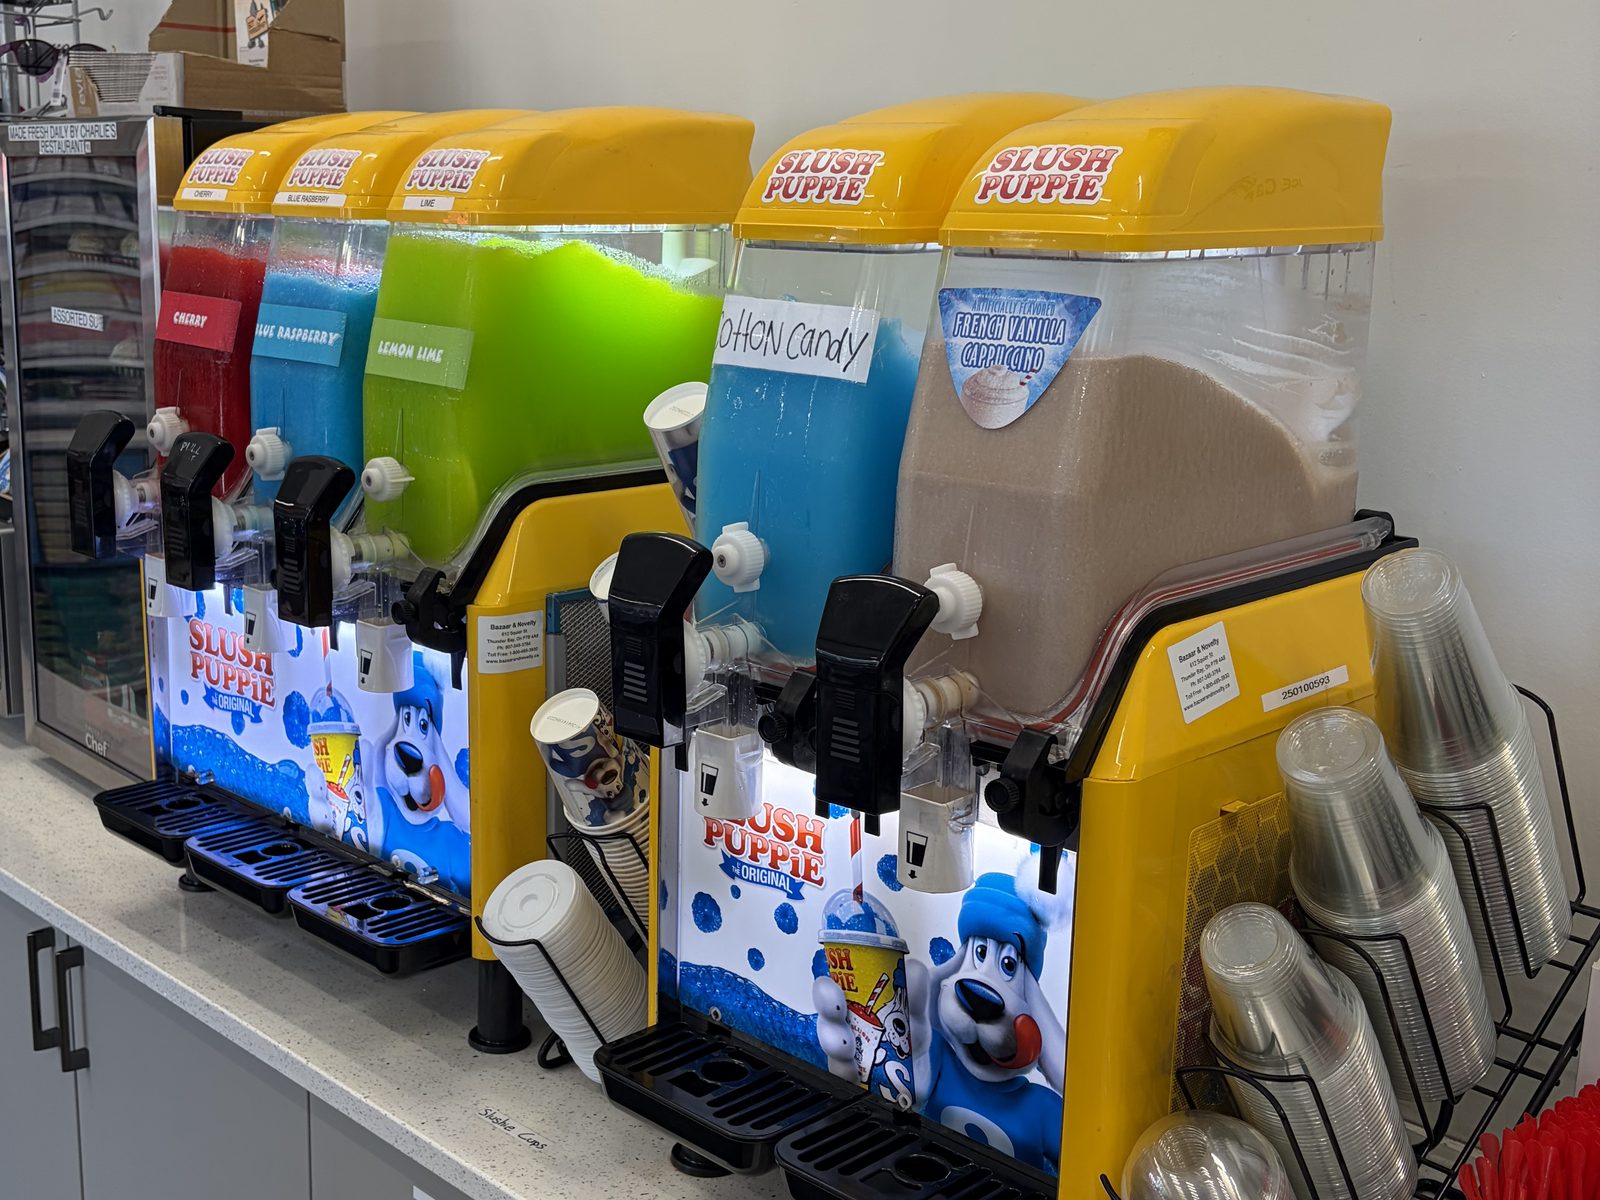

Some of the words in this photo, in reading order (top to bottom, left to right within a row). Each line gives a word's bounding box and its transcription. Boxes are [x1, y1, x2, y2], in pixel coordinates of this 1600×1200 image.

[9, 126, 27, 139] MADE
[27, 126, 49, 139] FRESH
[50, 125, 68, 139] DAILY
[70, 125, 79, 139] BY
[41, 140, 85, 153] RESTAURANT
[198, 149, 251, 167] SLUSH
[297, 150, 360, 169] SLUSH
[416, 149, 489, 170] SLUSH
[776, 150, 883, 176] SLUSH
[989, 145, 1121, 174] SLUSH
[194, 191, 213, 199] CHERRY
[301, 195, 330, 204] RASBERRY
[420, 199, 436, 208] LIME
[53, 308, 88, 326] ASSORTED
[971, 299, 1018, 314] ARTIFICIALLY
[1019, 301, 1056, 317] FLAVORED
[173, 311, 208, 328] CHERRY
[953, 312, 1006, 341] FRENCH
[1007, 315, 1067, 345] VANILLA
[277, 325, 338, 346] RASPBERRY
[377, 340, 414, 359] LEMON
[416, 346, 443, 363] LIME
[961, 342, 1045, 374] CAPPUCCINO
[1178, 650, 1196, 663] Bazaar
[1196, 646, 1201, 654] &
[1201, 638, 1219, 651] Novelty
[1181, 671, 1196, 683] Thunder
[1281, 675, 1331, 700] 250100593
[218, 694, 255, 718] ORIGINAL
[85, 732, 108, 757] Chef
[724, 802, 826, 855] USH
[741, 864, 793, 894] ORIGINAL
[518, 1132, 548, 1149] Cups
